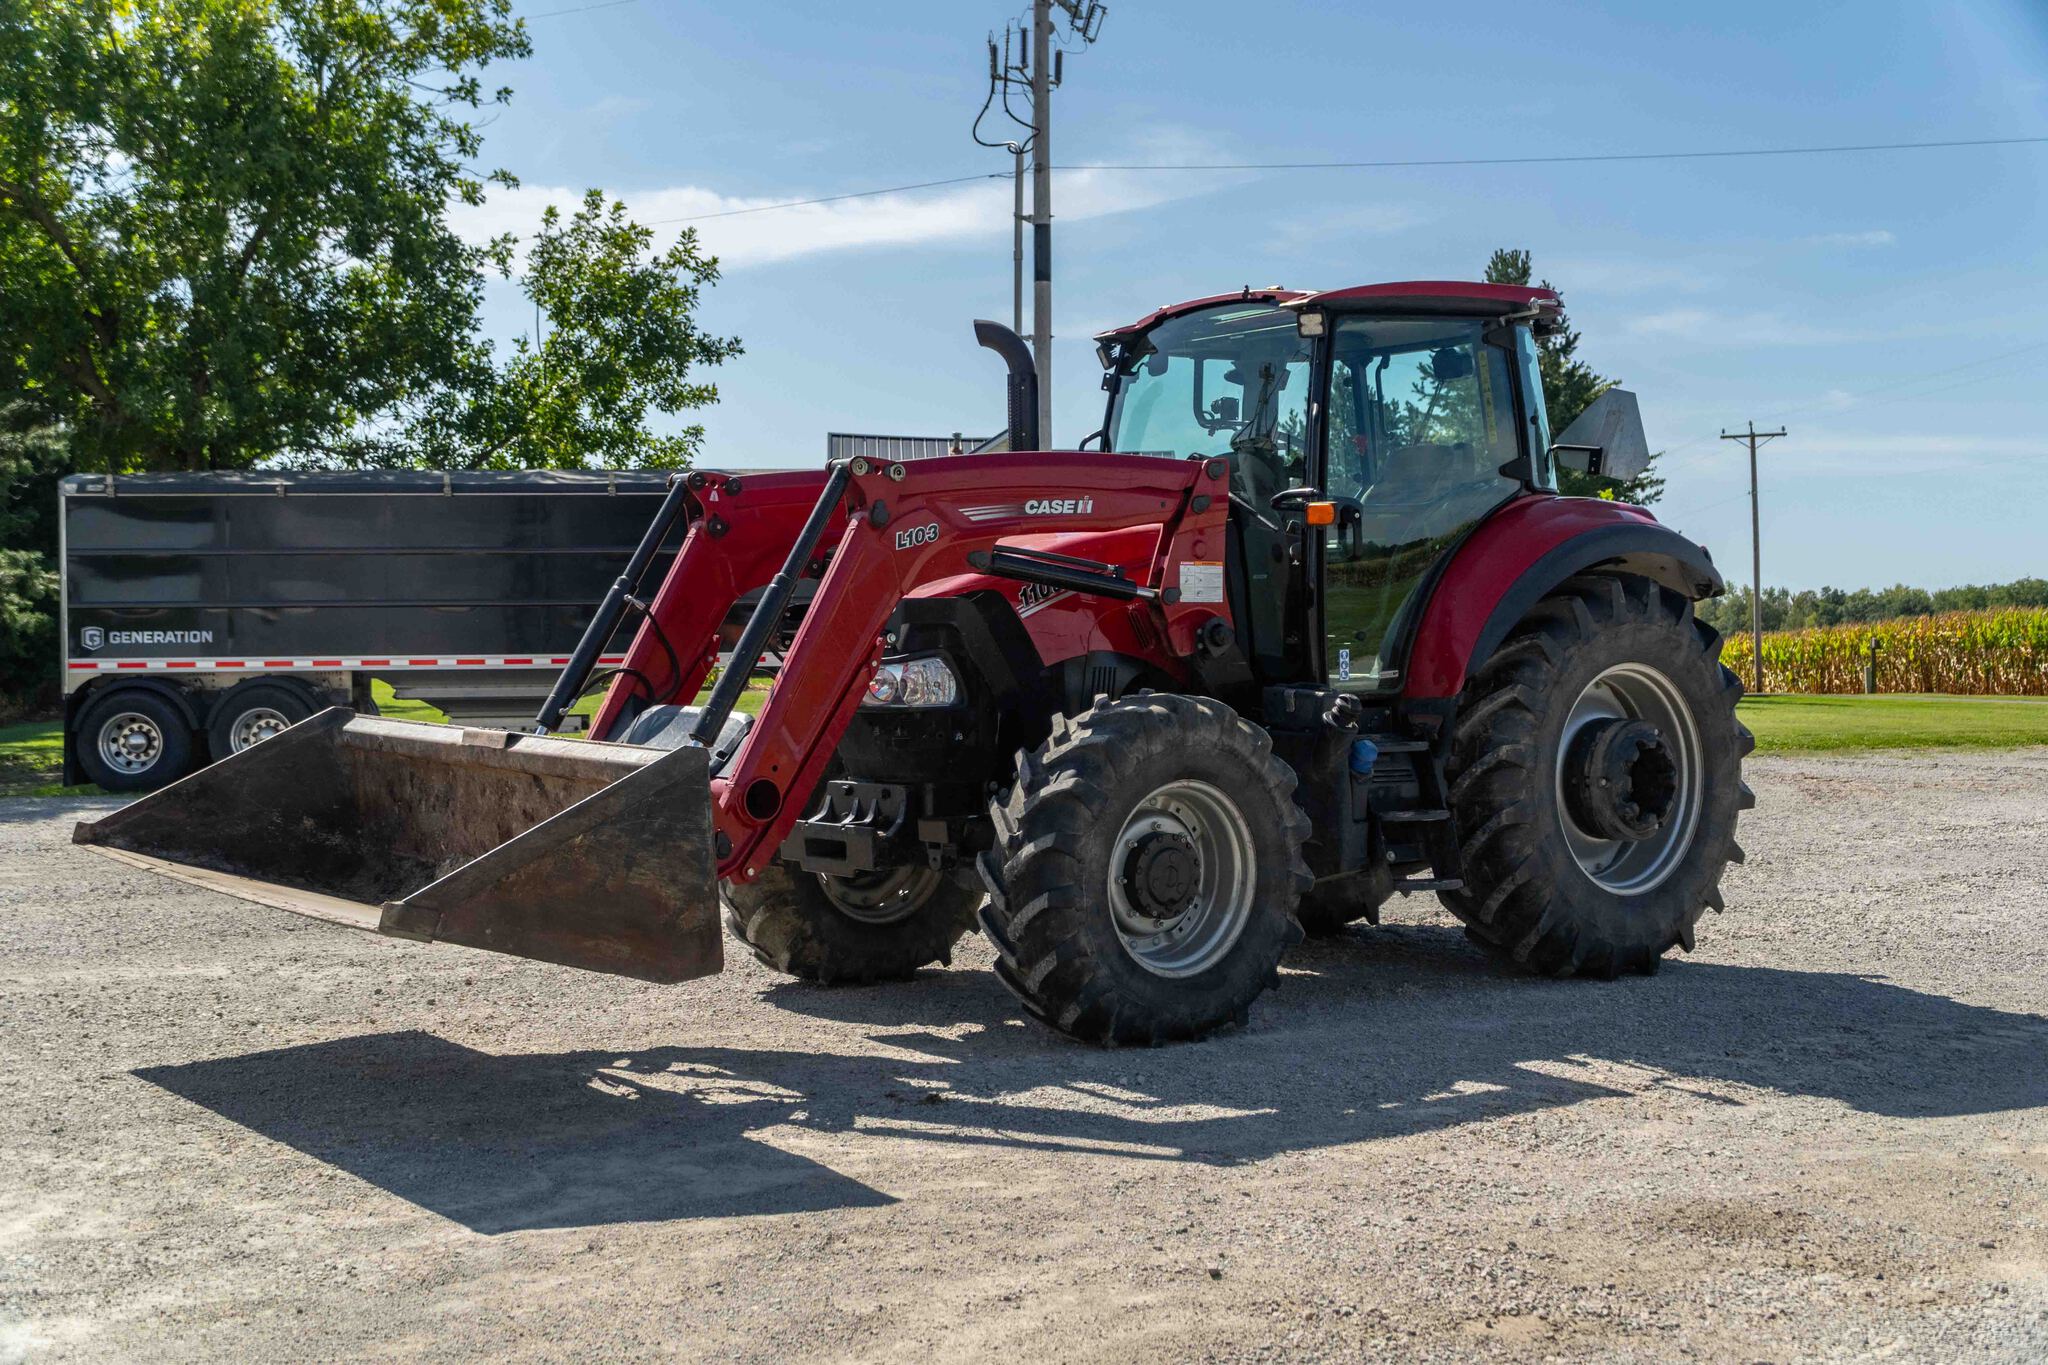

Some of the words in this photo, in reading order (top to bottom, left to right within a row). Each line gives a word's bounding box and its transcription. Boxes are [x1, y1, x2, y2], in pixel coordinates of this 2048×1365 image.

[1024, 499, 1076, 515] CASE
[896, 523, 939, 550] L103
[1019, 583, 1059, 607] 110
[109, 631, 213, 644] GENERATION
